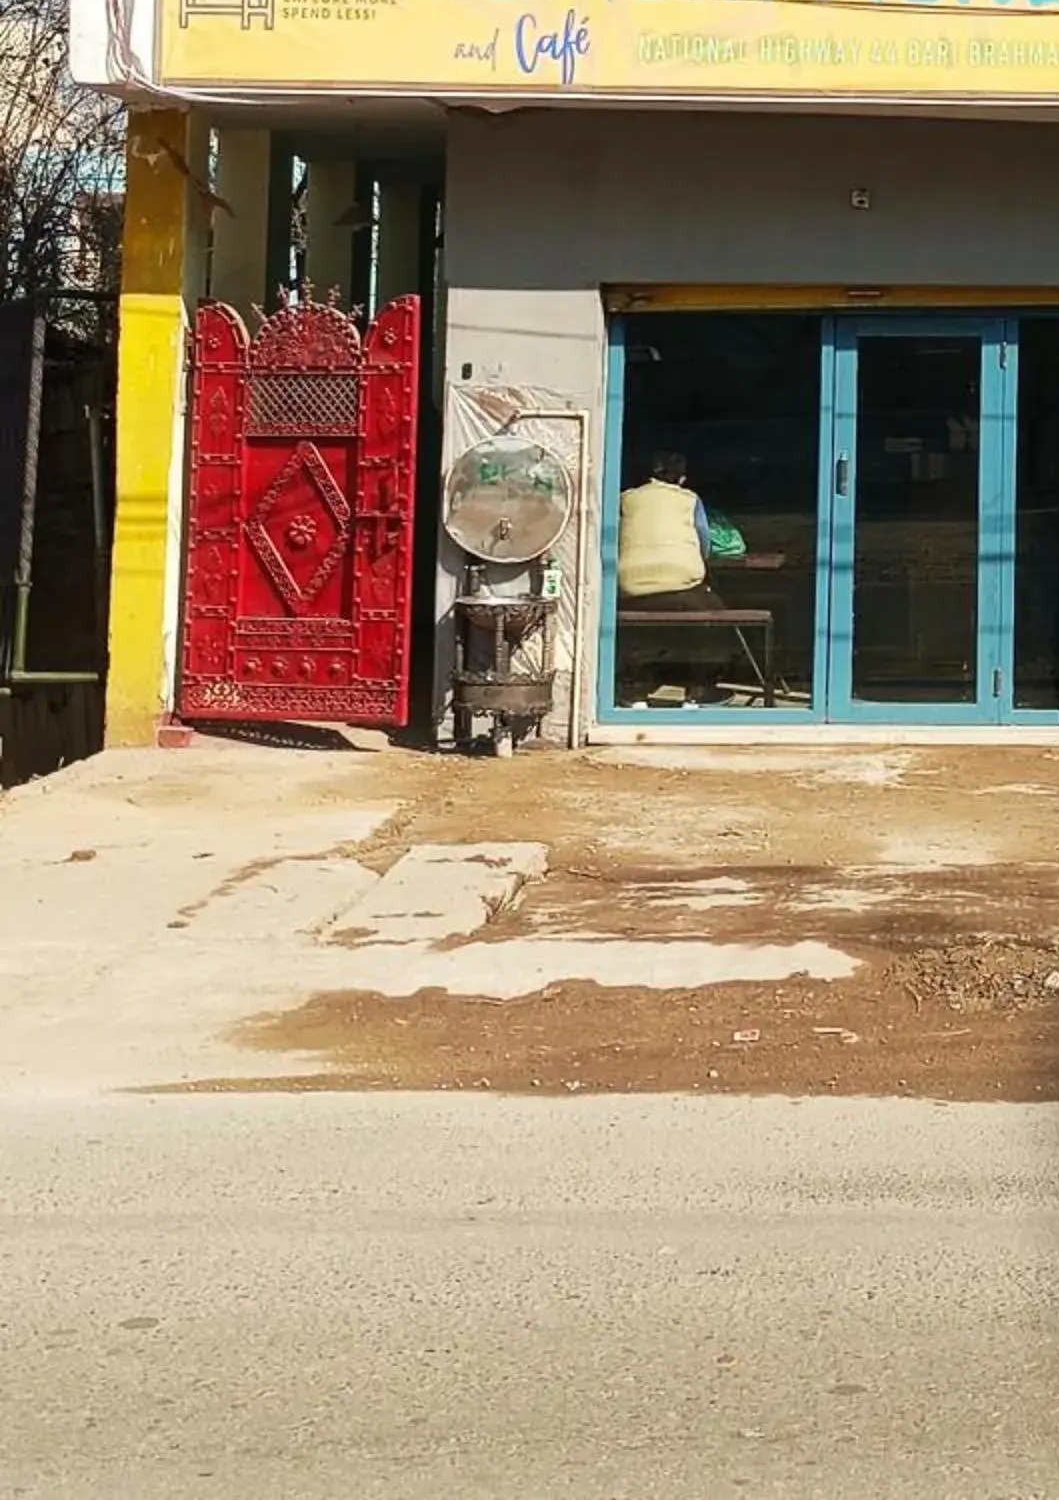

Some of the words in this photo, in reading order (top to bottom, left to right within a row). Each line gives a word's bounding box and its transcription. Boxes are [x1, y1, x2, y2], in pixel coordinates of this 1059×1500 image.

[282, 7, 331, 20] SPEND
[337, 8, 377, 21] LESS!
[453, 28, 499, 72] and
[515, 8, 591, 85] Café
[637, 34, 747, 64] NATIONAL
[758, 36, 862, 65] HIGHWAY
[907, 38, 957, 66] BARI
